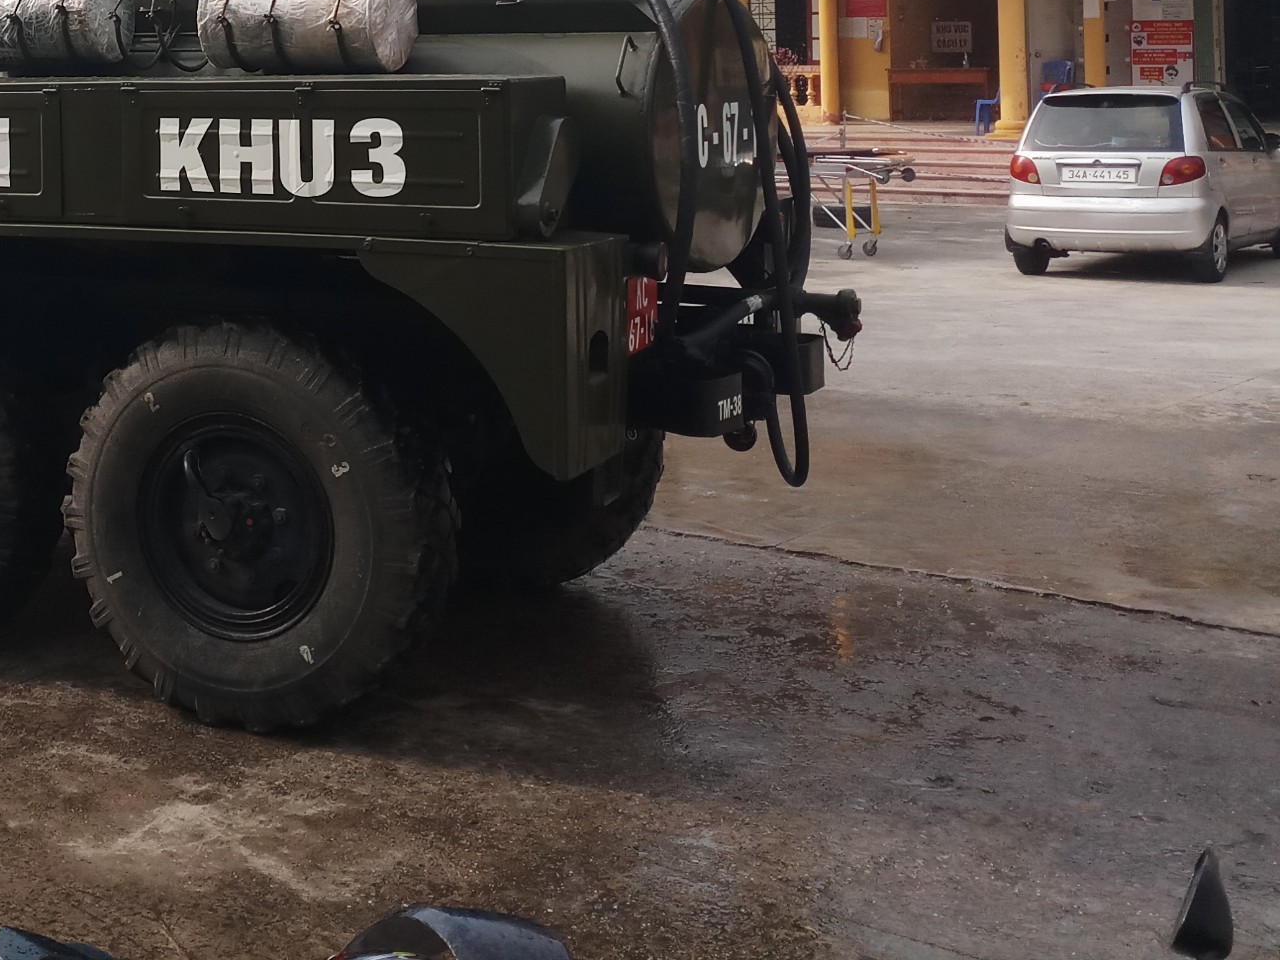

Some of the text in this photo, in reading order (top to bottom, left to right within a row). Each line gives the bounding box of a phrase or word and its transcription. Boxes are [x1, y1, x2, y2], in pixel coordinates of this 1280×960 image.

[158, 117, 336, 198] KHU
[350, 117, 408, 199] 3
[1068, 169, 1130, 180] 34A-441.45
[718, 393, 742, 421] TM-38
